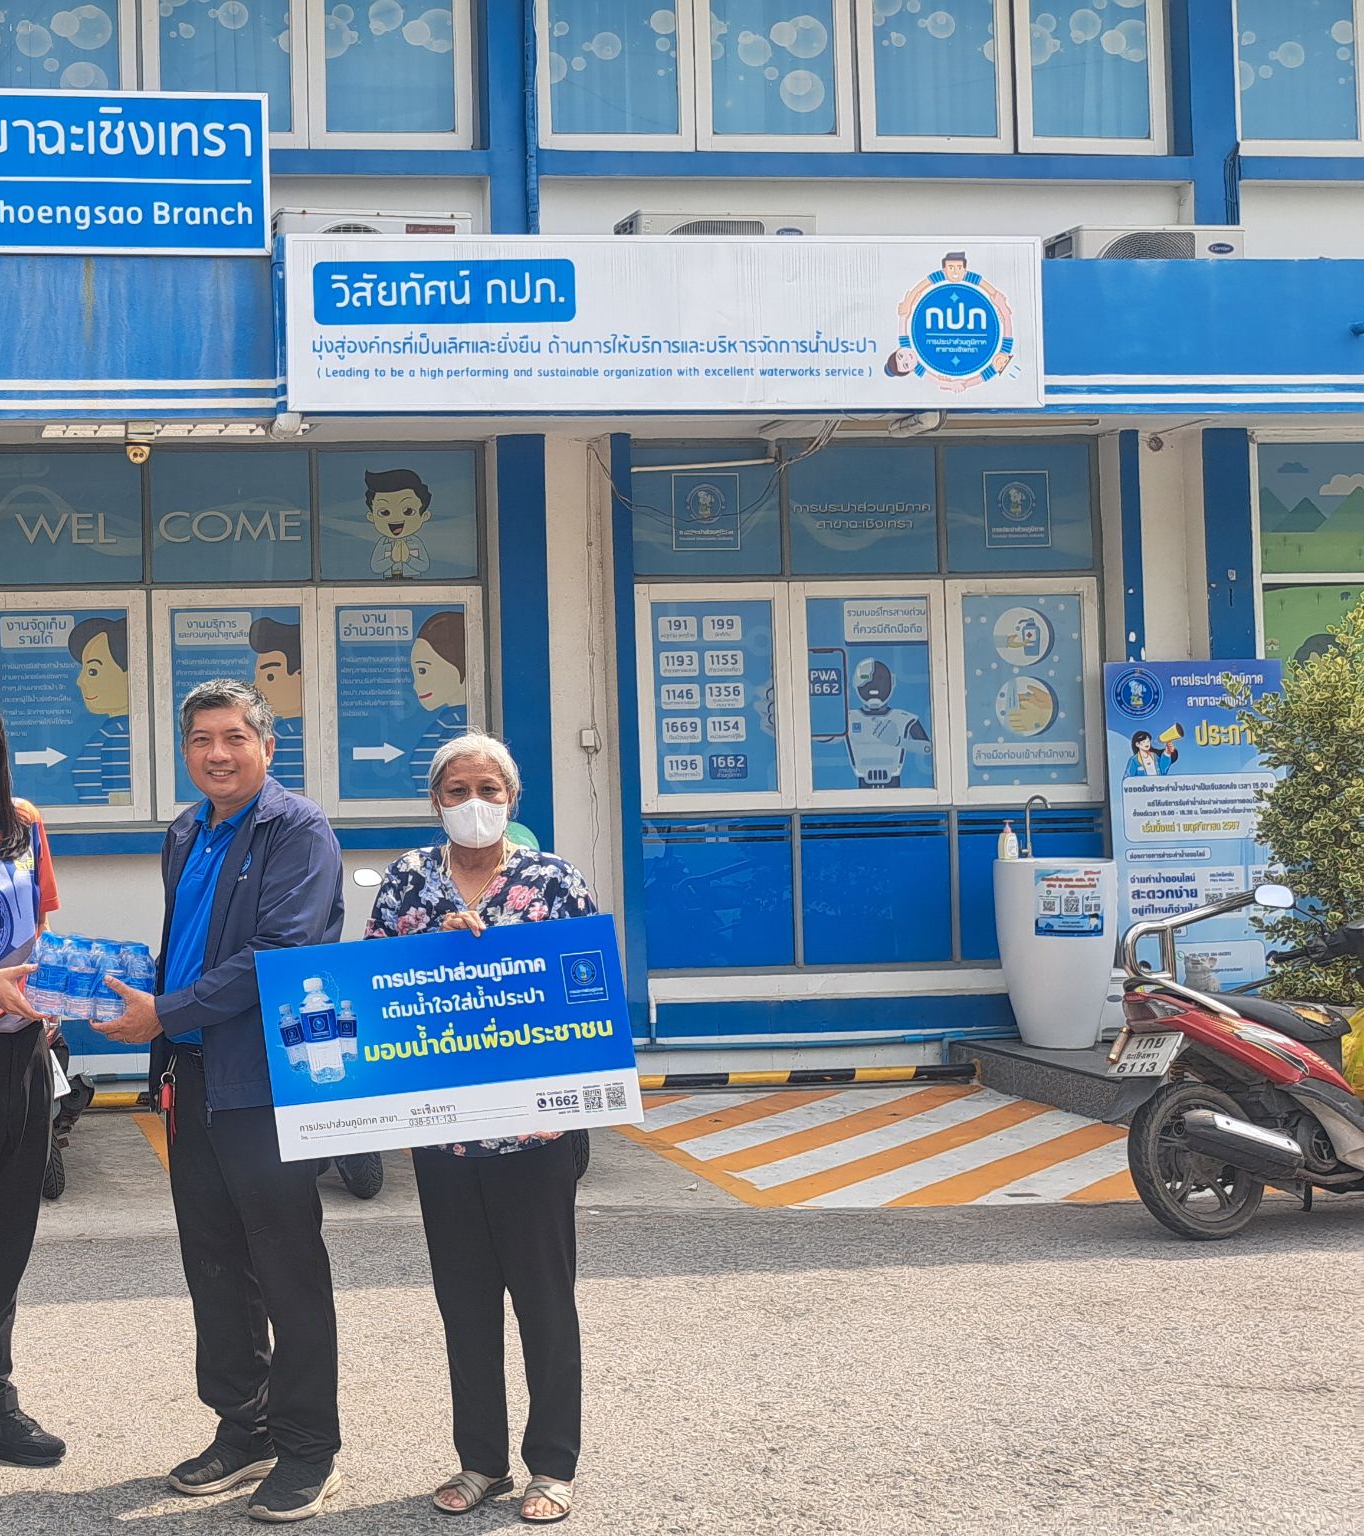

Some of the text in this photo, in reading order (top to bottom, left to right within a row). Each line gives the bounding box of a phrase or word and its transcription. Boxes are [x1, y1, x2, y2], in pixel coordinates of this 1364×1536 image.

[153, 201, 253, 226] Branch
[331, 269, 567, 308] วิสัยทัศน์ กปภ.
[925, 302, 987, 330] กปภ
[312, 330, 877, 360] มุ่งสู่องค์กรที่เป็นเลิศและยั่งยืน ด้านการให้บริการและบริหารจัดการน้ำประปา
[325, 367, 370, 380] Leading
[374, 368, 386, 377] to
[390, 367, 404, 377] be
[420, 367, 443, 379] high
[446, 367, 509, 379] performing
[513, 367, 533, 377] and
[537, 366, 599, 377] sustainable
[603, 366, 673, 380] organization
[677, 366, 700, 377] with
[704, 366, 755, 377] excellent
[759, 366, 821, 377] waterworks
[825, 366, 864, 377] service
[15, 509, 303, 545] WEL COME
[186, 618, 238, 629] งานบริการ
[362, 612, 387, 624] งาน
[710, 618, 734, 630] 199
[343, 624, 409, 637] อำนวยการ
[667, 619, 688, 631] 191
[664, 655, 694, 666] 1193
[709, 654, 738, 666] 1155
[810, 670, 838, 681] PWA
[665, 688, 694, 700] 1146
[708, 685, 741, 697] 1356
[810, 683, 840, 694] 1662
[664, 721, 698, 733] 1669
[711, 720, 740, 732] 1154
[1195, 719, 1258, 747] ประกา
[668, 759, 698, 771] 1196
[711, 755, 745, 768] 1662
[1131, 886, 1198, 900] สะดวกง่าย
[371, 955, 547, 990] การประปาส่วนภูมิภาค
[382, 985, 546, 1020] เติมน้ำใจใส่น้ำประปา
[364, 1017, 614, 1063] มอบน้ำดื่มเพื่อประชาชน
[1137, 1037, 1167, 1050] 1กย
[1116, 1061, 1158, 1074] 6113
[548, 1094, 579, 1108] 1662
[299, 1116, 378, 1132] การประปาส่วนภูมิภาค
[410, 1103, 456, 1116] ฉะเชิงเทรา
[408, 1114, 457, 1128] 038-511-133
